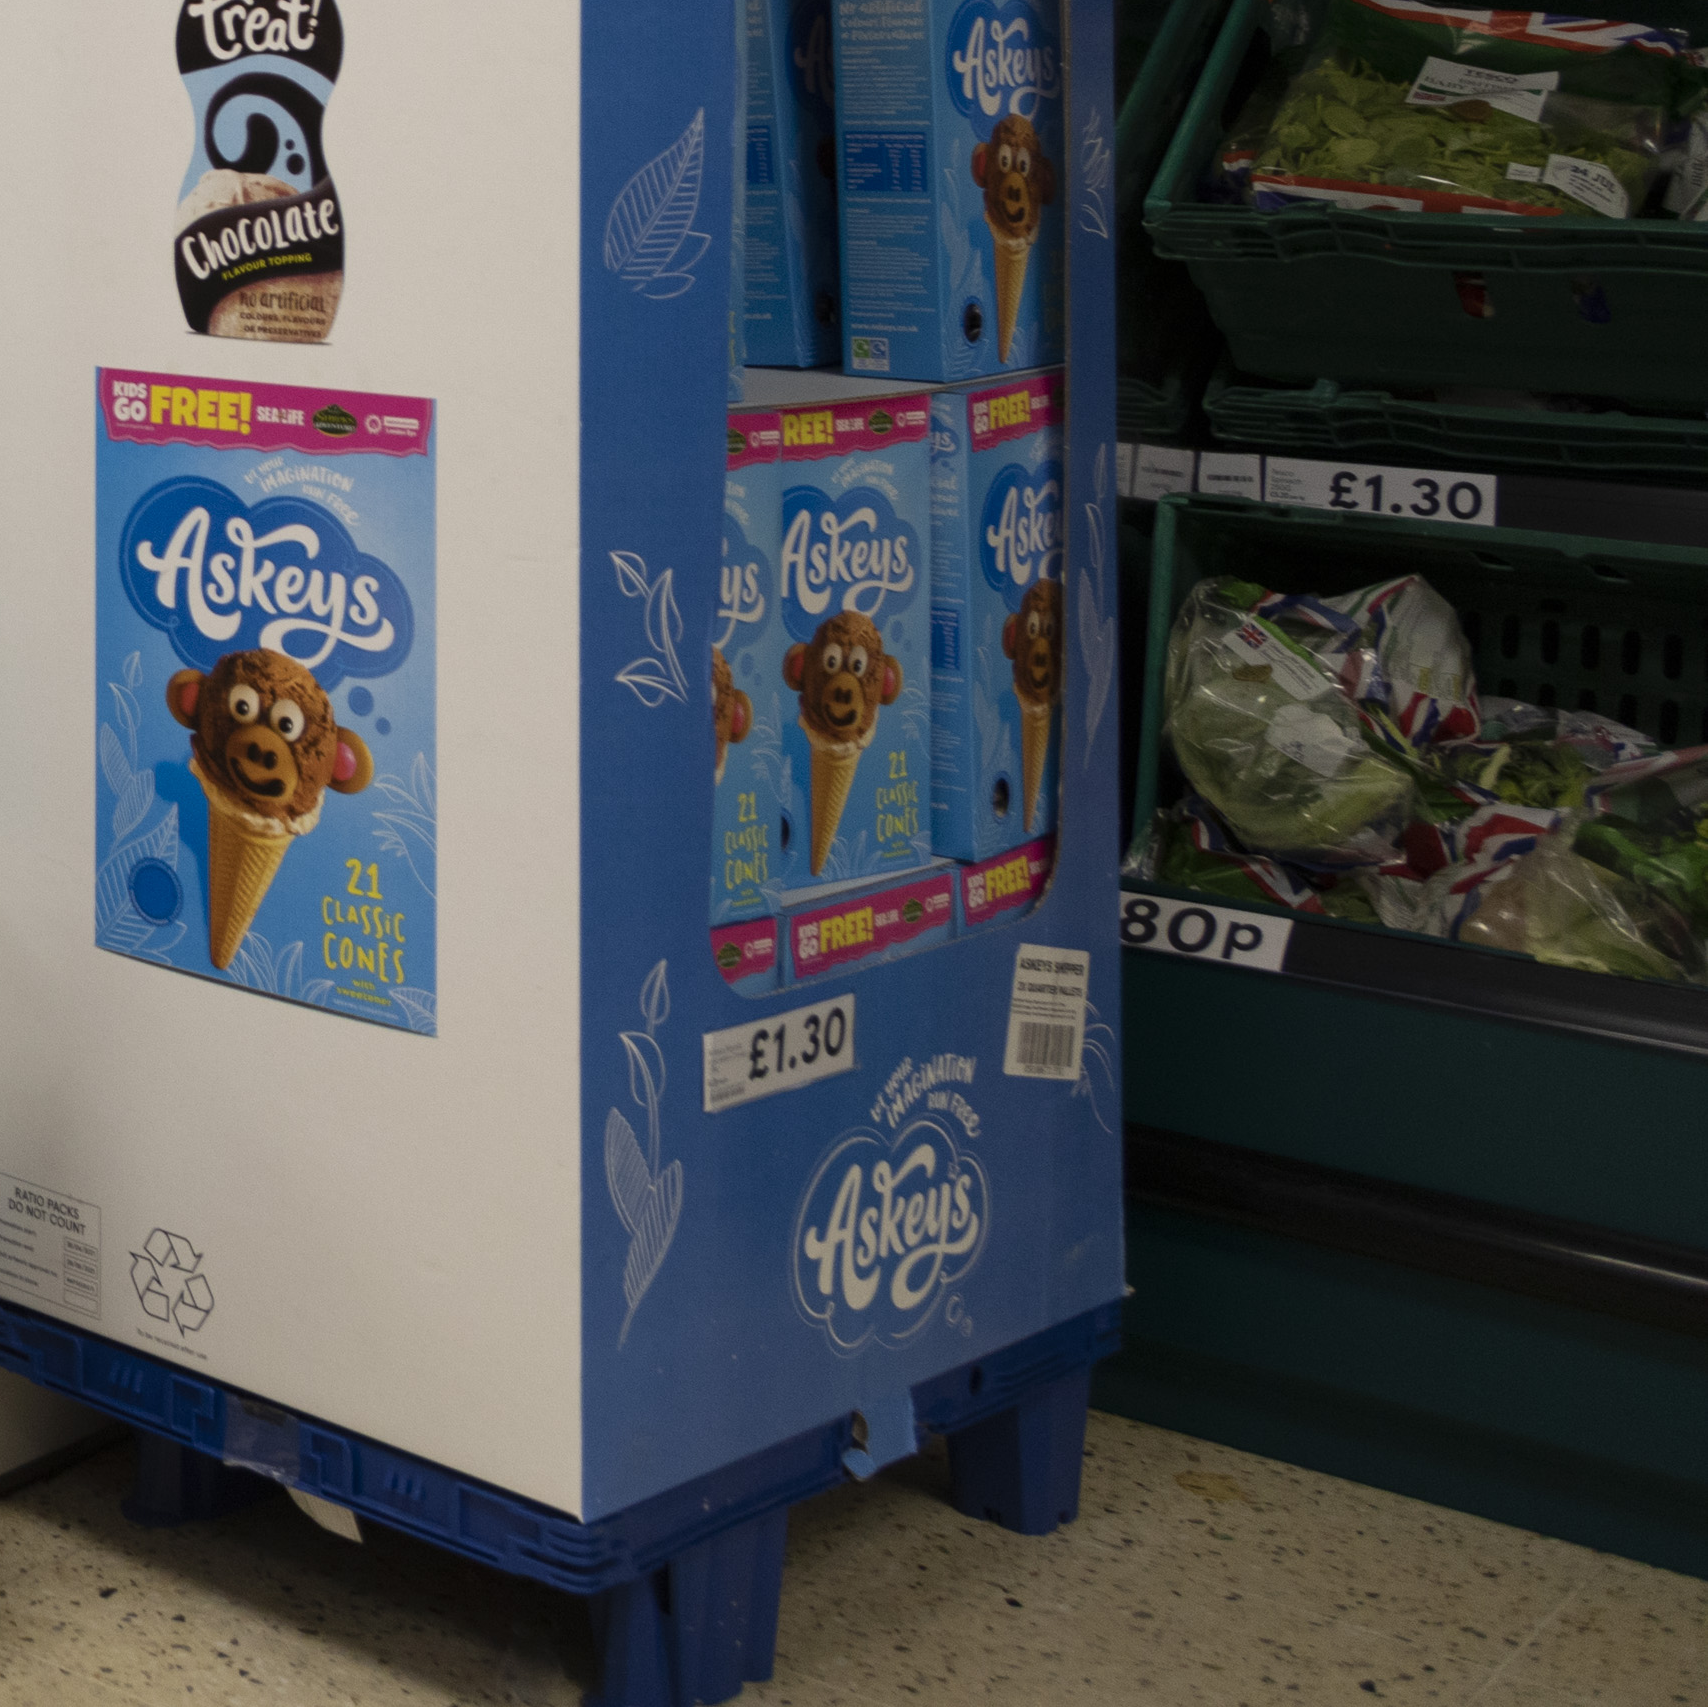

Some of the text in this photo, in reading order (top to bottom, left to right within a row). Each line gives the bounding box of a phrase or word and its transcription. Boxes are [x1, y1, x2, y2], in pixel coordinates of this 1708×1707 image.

[953, 16, 1056, 119] Askeys
[221, 251, 312, 282] FLAVOUR TOPPING
[112, 380, 147, 400] KIDS
[113, 398, 146, 423] GO
[150, 384, 252, 436] FREE!
[989, 390, 1031, 432] FREE!
[260, 464, 355, 493] IMAGINATION
[1328, 469, 1484, 522] £1.30
[781, 506, 915, 616] Askeys
[135, 505, 397, 669] Askeys
[889, 750, 907, 779] 21
[737, 792, 759, 823] 21
[877, 806, 919, 842] CONES
[345, 858, 384, 900] 21
[725, 855, 769, 890] CONES
[984, 855, 1032, 903] FREE!
[321, 895, 406, 944] CLASSIC
[819, 906, 874, 954] FREE!
[1121, 897, 1265, 962] 80p
[322, 931, 405, 984] CONES
[747, 1006, 847, 1081] £1.30
[886, 1053, 978, 1129] IMAGINATION
[8, 1197, 87, 1237] DO NOT COUNT
[15, 1186, 80, 1221] RATIO PACKS
[804, 1143, 979, 1311] Askeys
